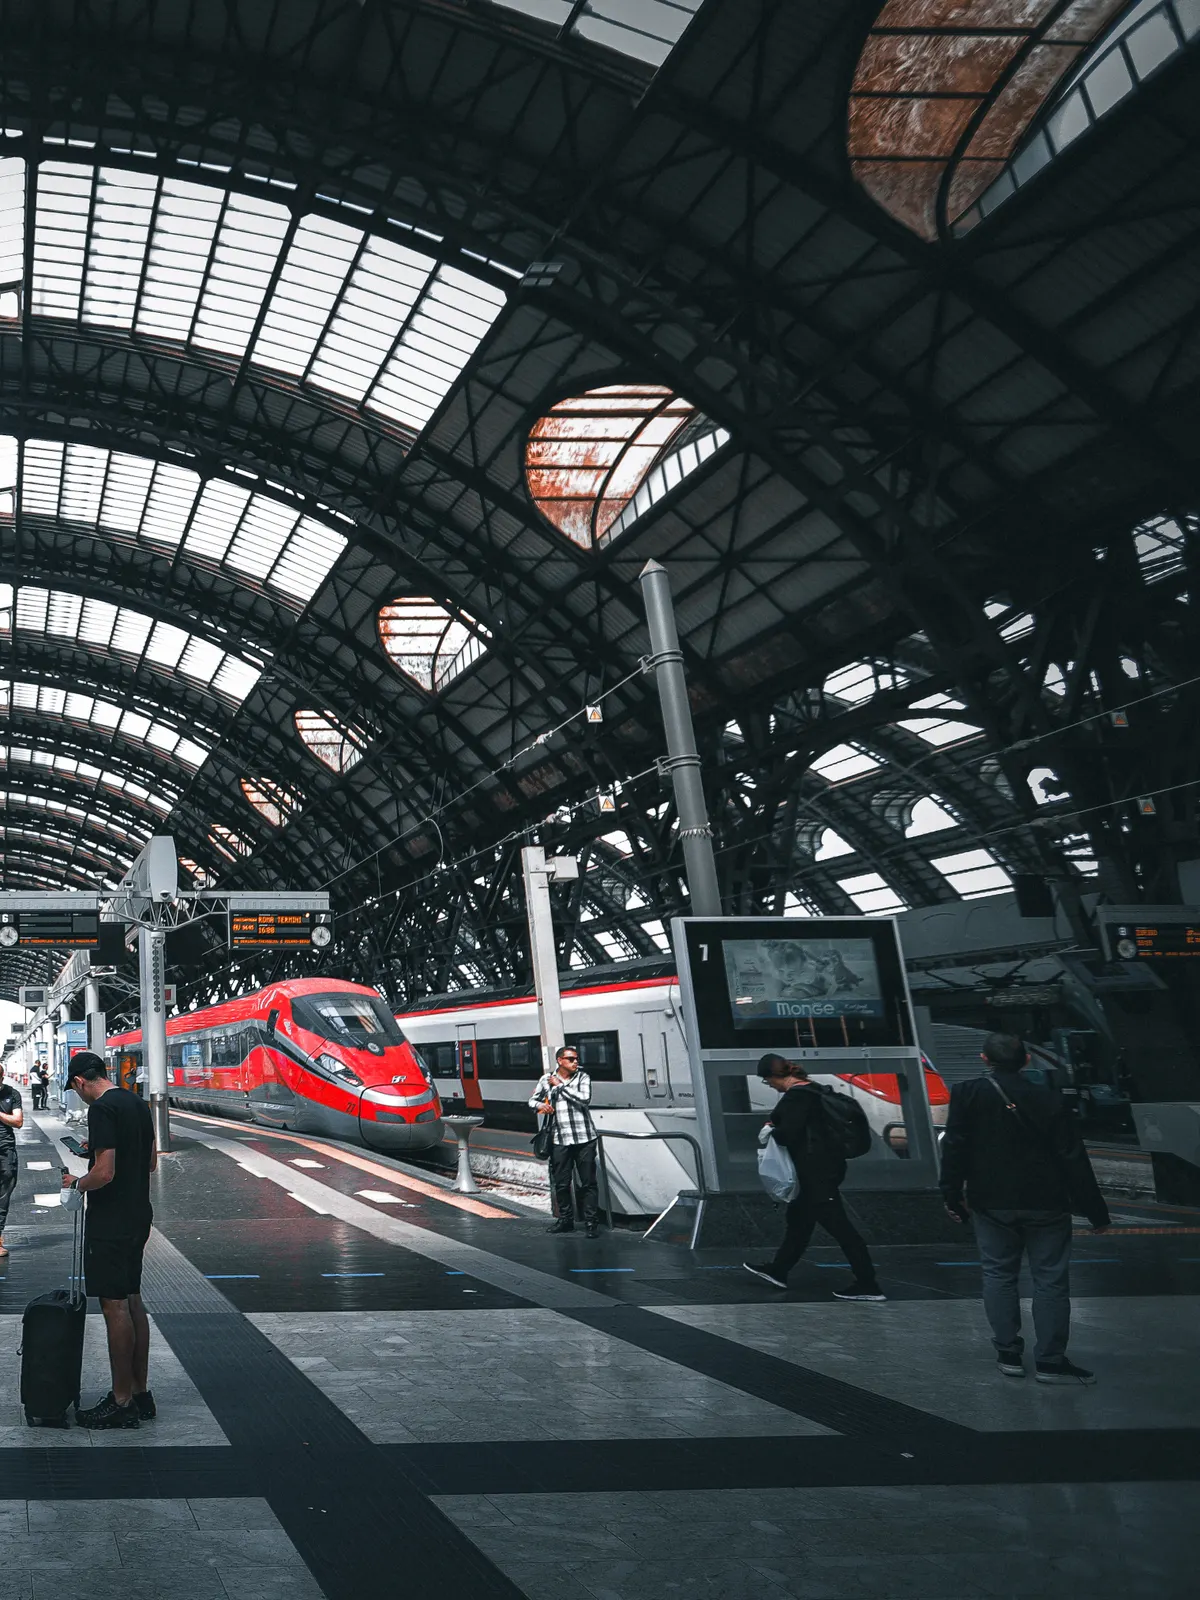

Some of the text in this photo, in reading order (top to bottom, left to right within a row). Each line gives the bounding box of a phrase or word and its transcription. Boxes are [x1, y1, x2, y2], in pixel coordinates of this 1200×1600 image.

[2, 914, 9, 923] 6
[258, 916, 275, 924] ROMA
[278, 916, 302, 924] TERMINI
[319, 914, 326, 923] 7
[699, 944, 709, 962] 7
